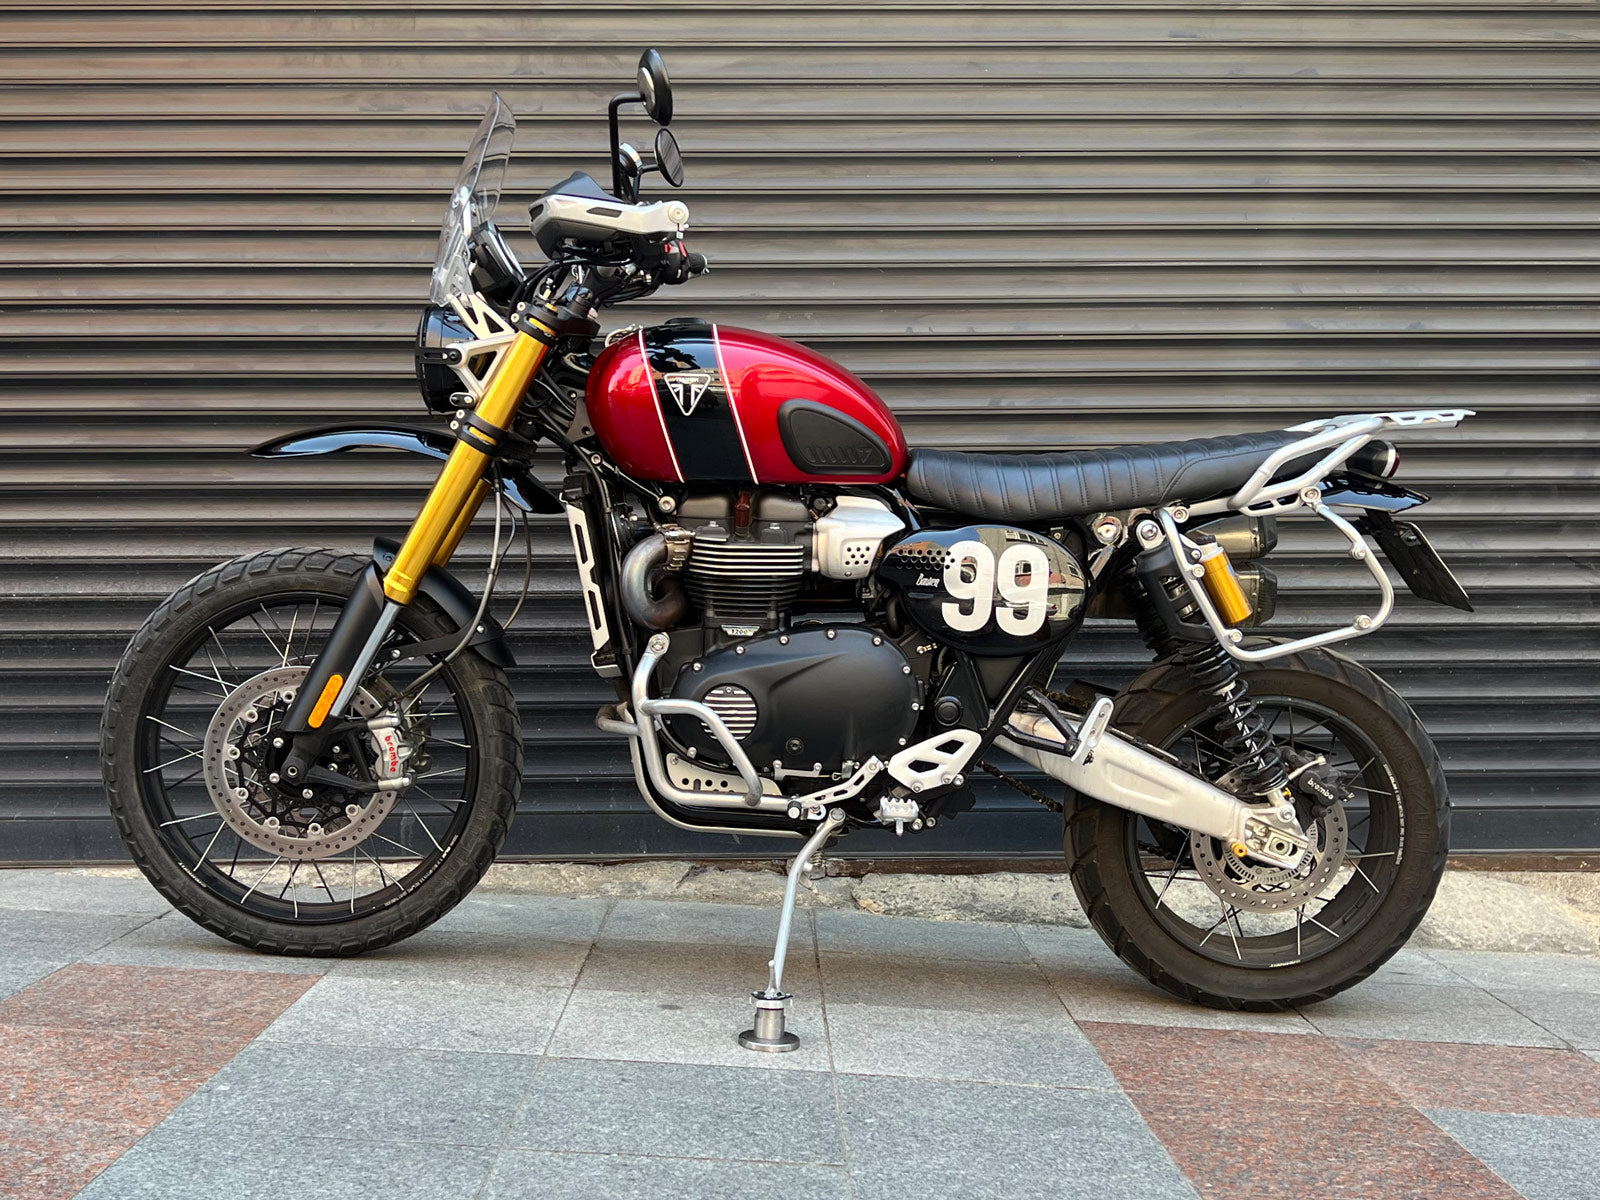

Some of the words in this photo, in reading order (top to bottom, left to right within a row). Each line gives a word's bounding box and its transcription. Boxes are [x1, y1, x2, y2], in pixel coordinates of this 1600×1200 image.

[942, 540, 1050, 637] 99
[384, 735, 399, 773] brembo
[1307, 777, 1334, 800] brembo
